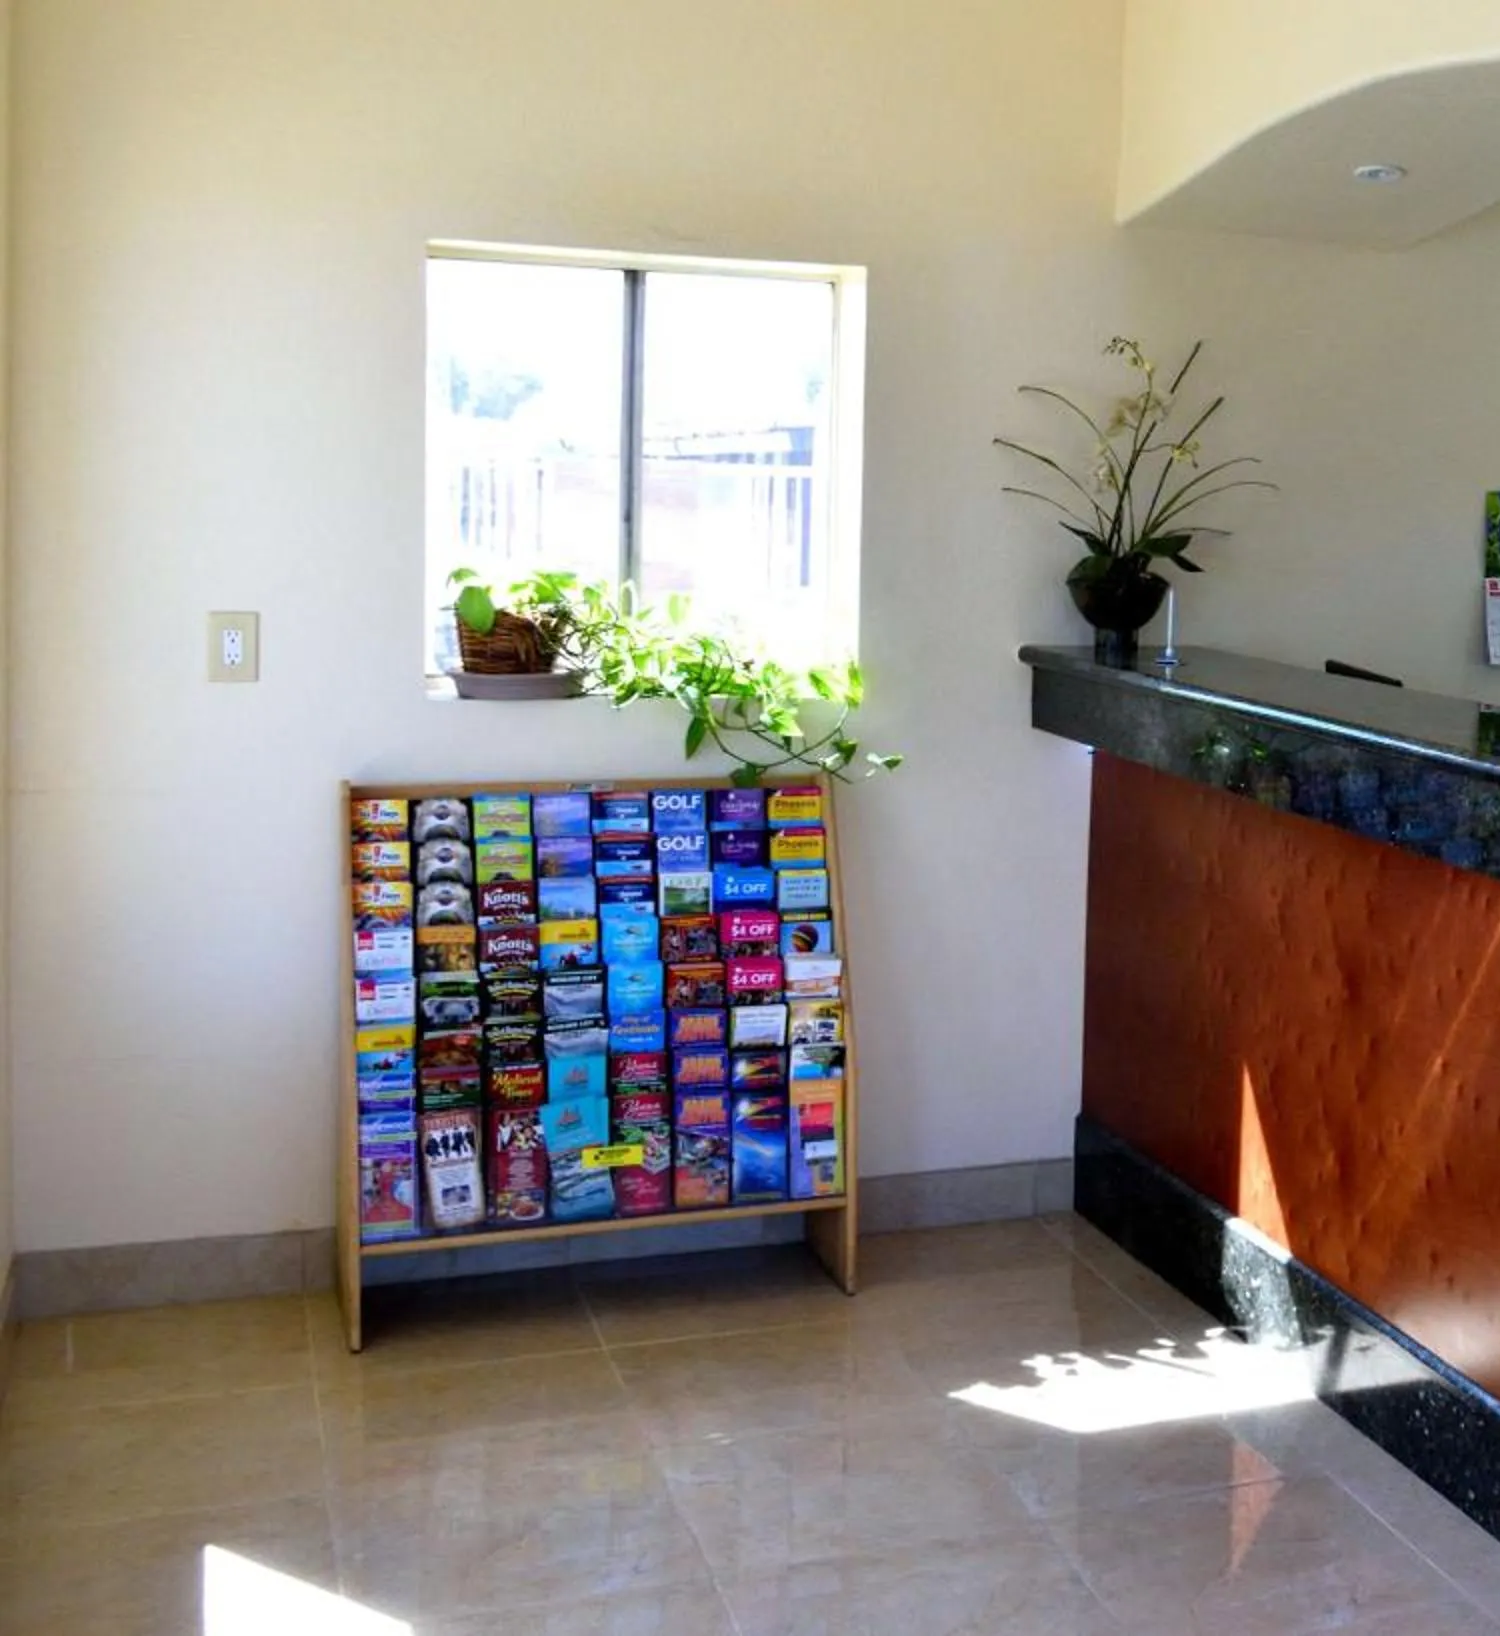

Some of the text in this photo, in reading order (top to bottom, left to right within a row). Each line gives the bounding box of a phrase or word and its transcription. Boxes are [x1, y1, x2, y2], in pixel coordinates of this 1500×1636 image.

[652, 795, 701, 810] GOLF
[657, 835, 704, 851] GOLF
[724, 883, 768, 895] $4 OFF
[731, 925, 774, 937] $4 OFF
[733, 973, 776, 985] $4 OFF
